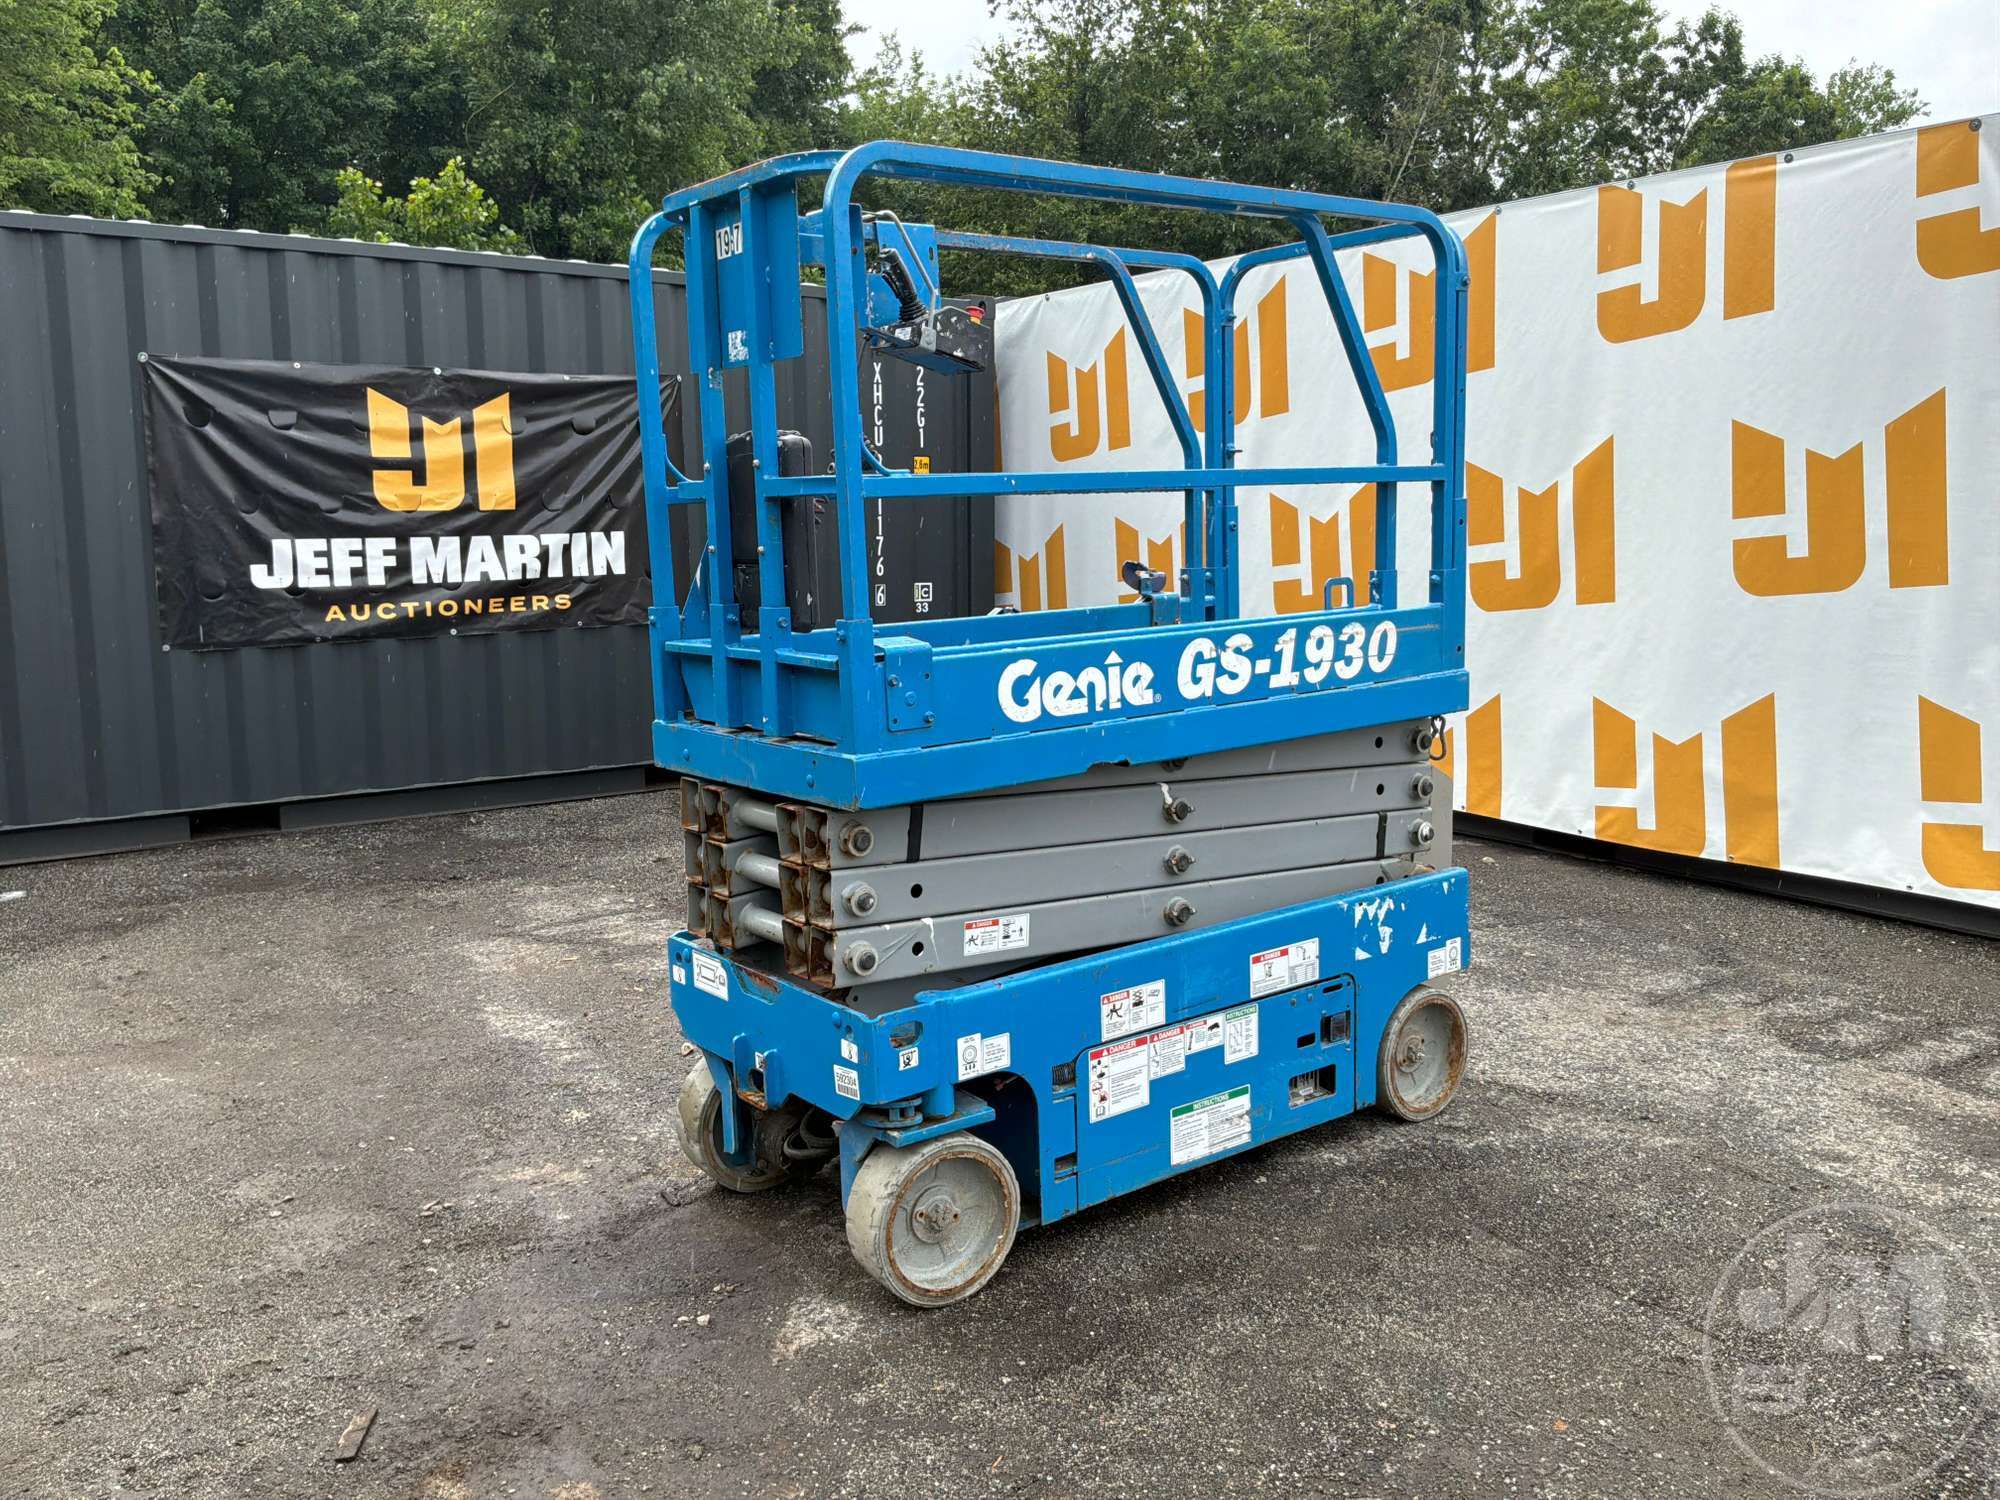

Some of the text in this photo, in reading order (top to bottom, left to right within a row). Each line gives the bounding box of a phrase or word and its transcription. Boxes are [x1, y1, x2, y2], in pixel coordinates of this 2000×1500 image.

[873, 362, 884, 447] XHCU
[916, 366, 926, 448] 22G1
[250, 530, 626, 590] JEFF MARTIN
[325, 594, 573, 622] AUCTIONEERS
[915, 602, 929, 613] 33
[1177, 620, 1398, 700] GS-1930
[1109, 1040, 1137, 1054] DANGER
